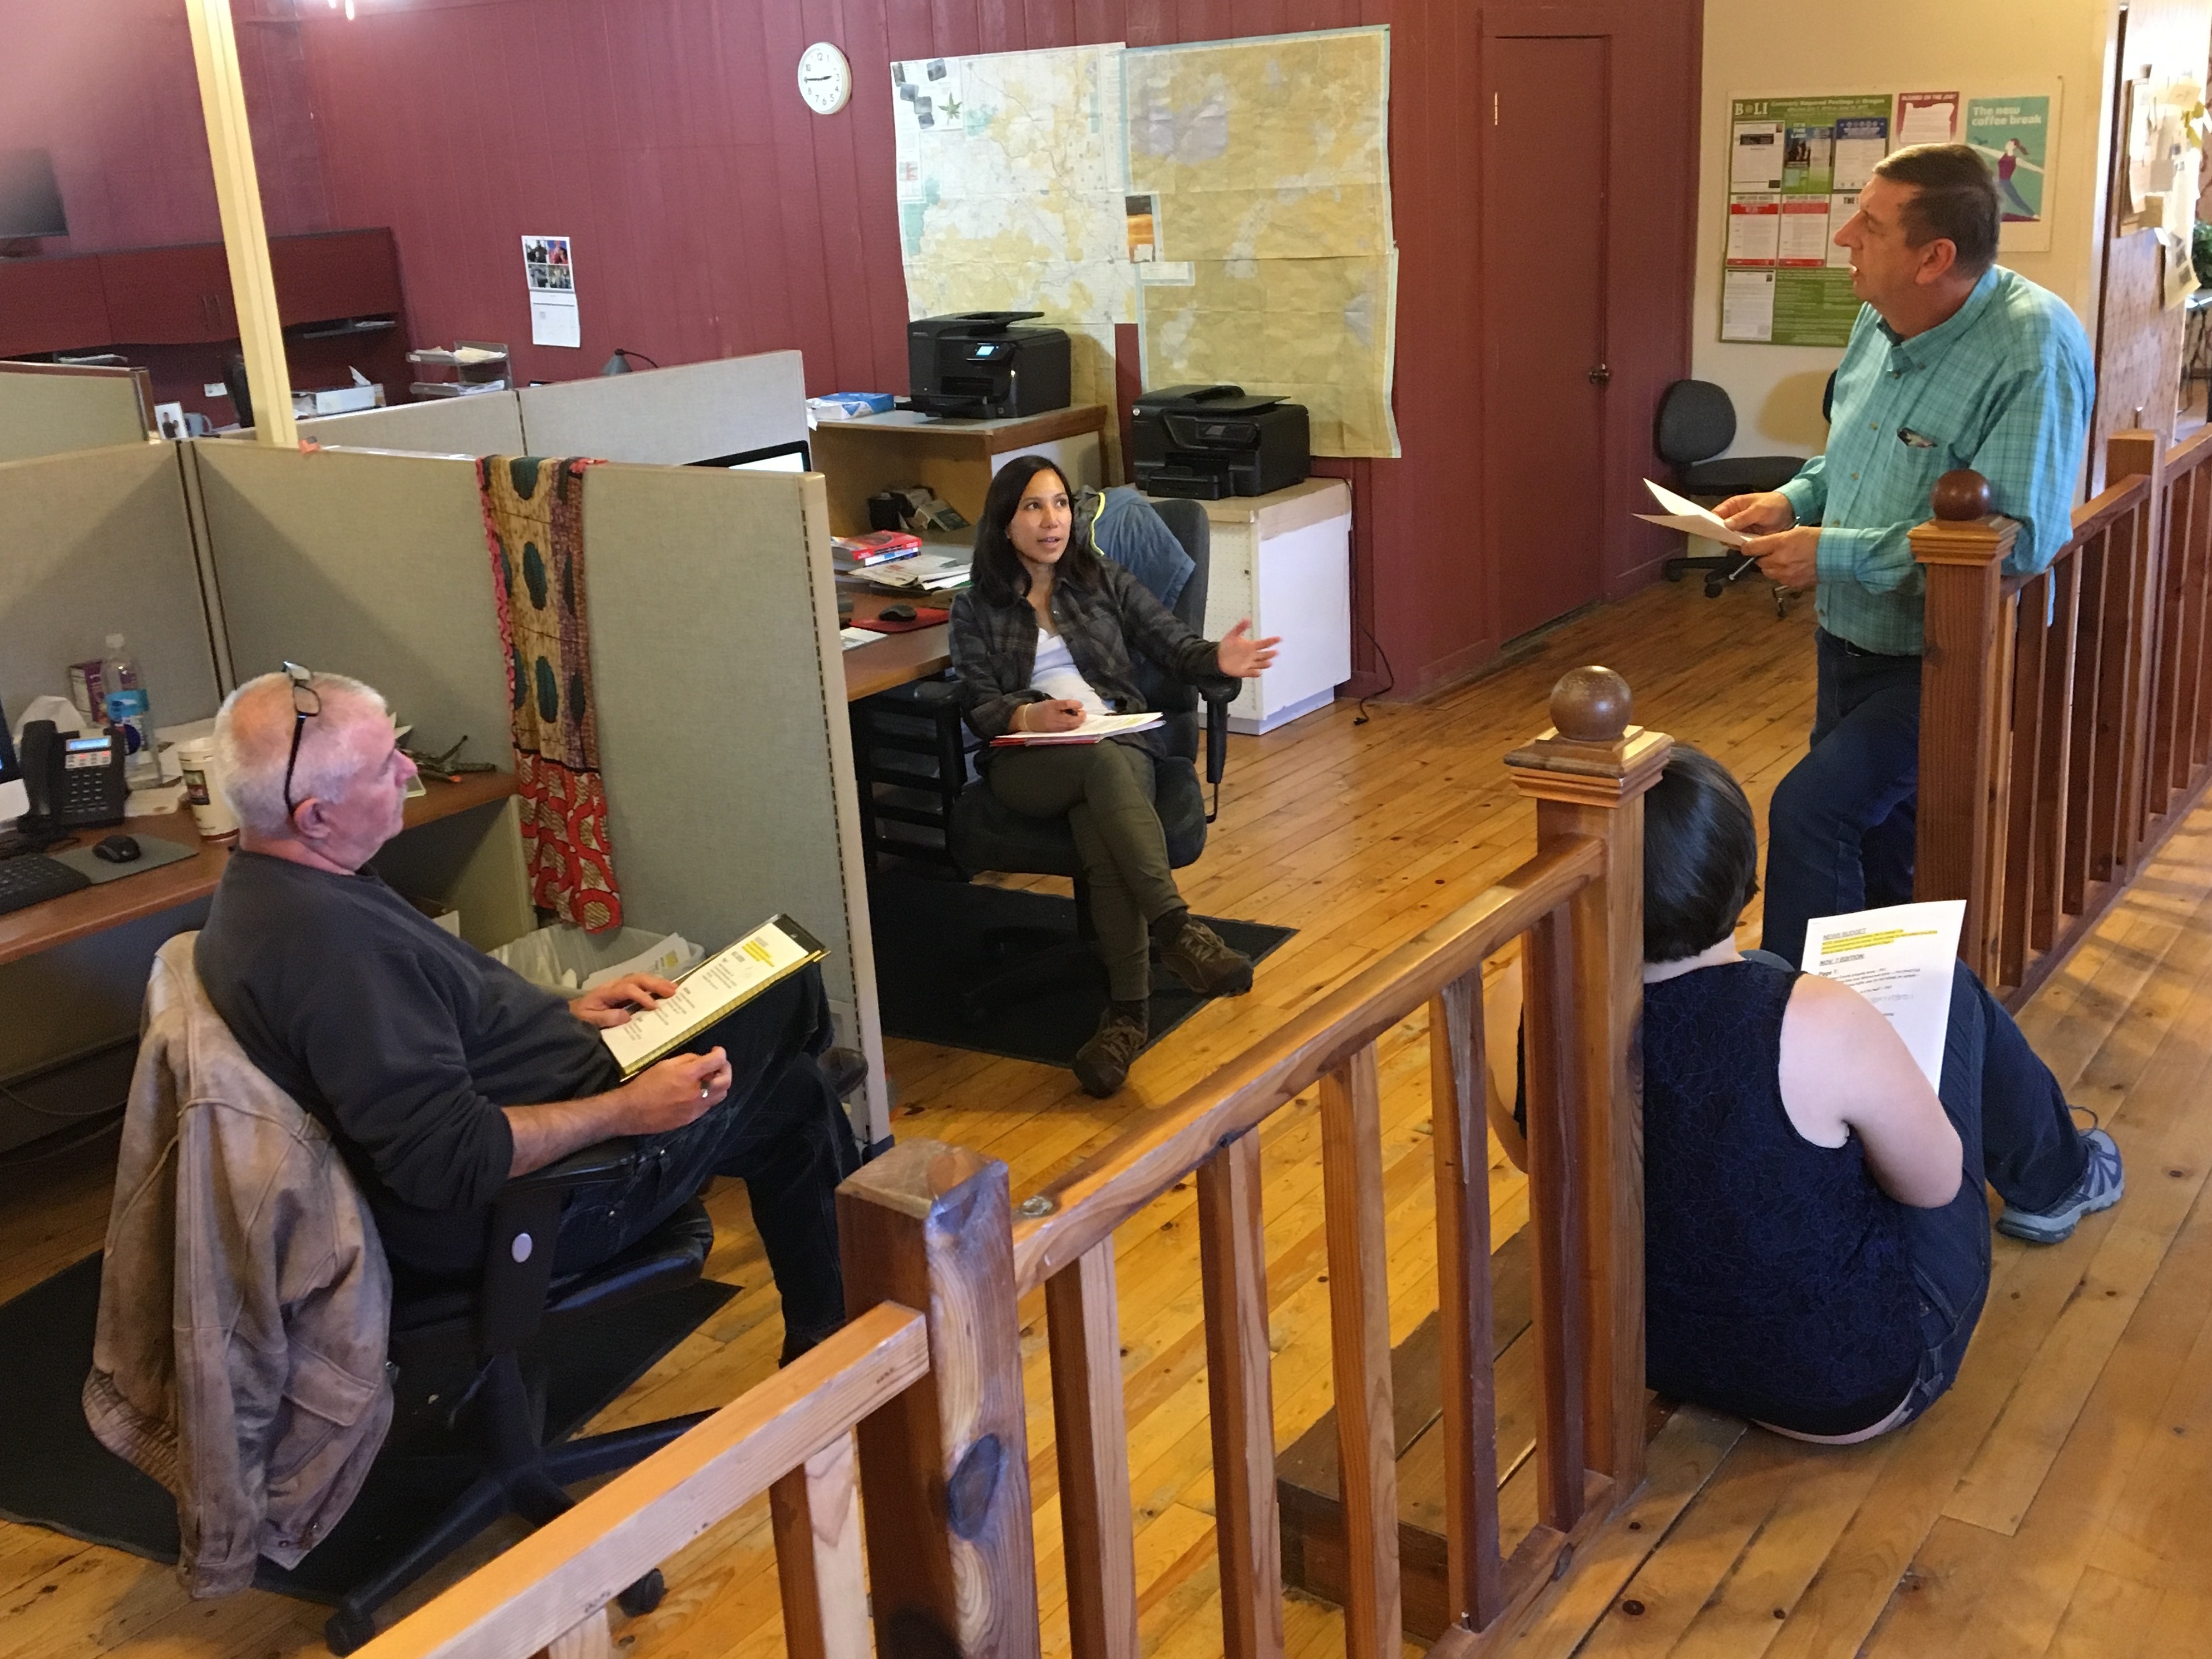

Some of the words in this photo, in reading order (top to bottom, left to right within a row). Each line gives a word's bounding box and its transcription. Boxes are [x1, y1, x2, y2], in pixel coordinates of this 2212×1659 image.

[817, 52, 823, 61] 12
[806, 64, 811, 72] 10
[836, 73, 840, 82] 3
[830, 94, 835, 102] 5
[1972, 107, 1993, 116] The
[1996, 106, 2020, 115] new
[1971, 115, 2007, 126] coffee
[2010, 115, 2041, 125] break
